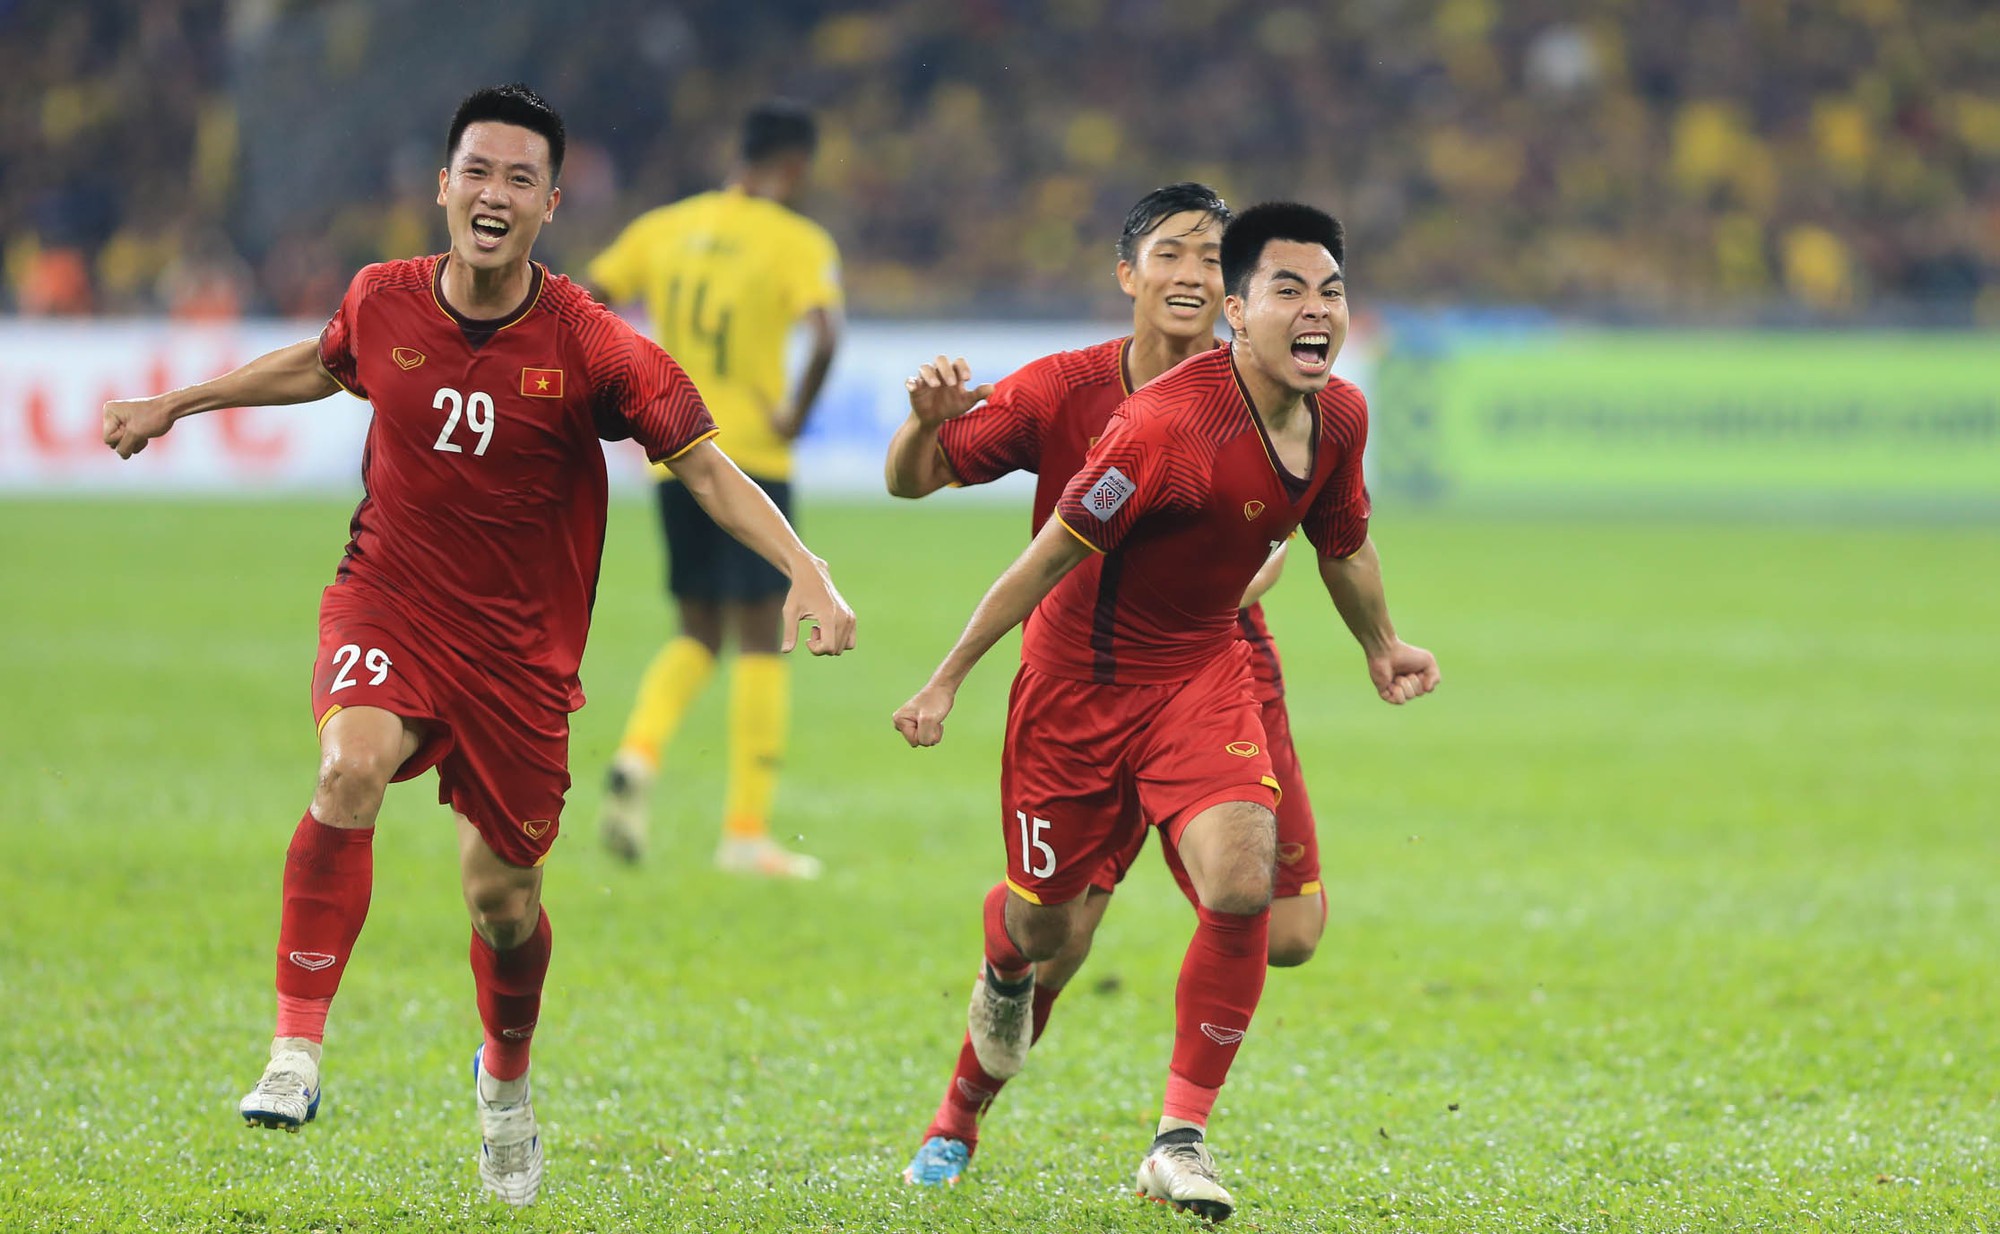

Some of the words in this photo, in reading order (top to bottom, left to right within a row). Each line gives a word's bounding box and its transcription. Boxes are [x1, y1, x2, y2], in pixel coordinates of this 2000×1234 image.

[432, 387, 495, 456] 29
[329, 644, 393, 695] 29
[1016, 809, 1057, 879] 15
